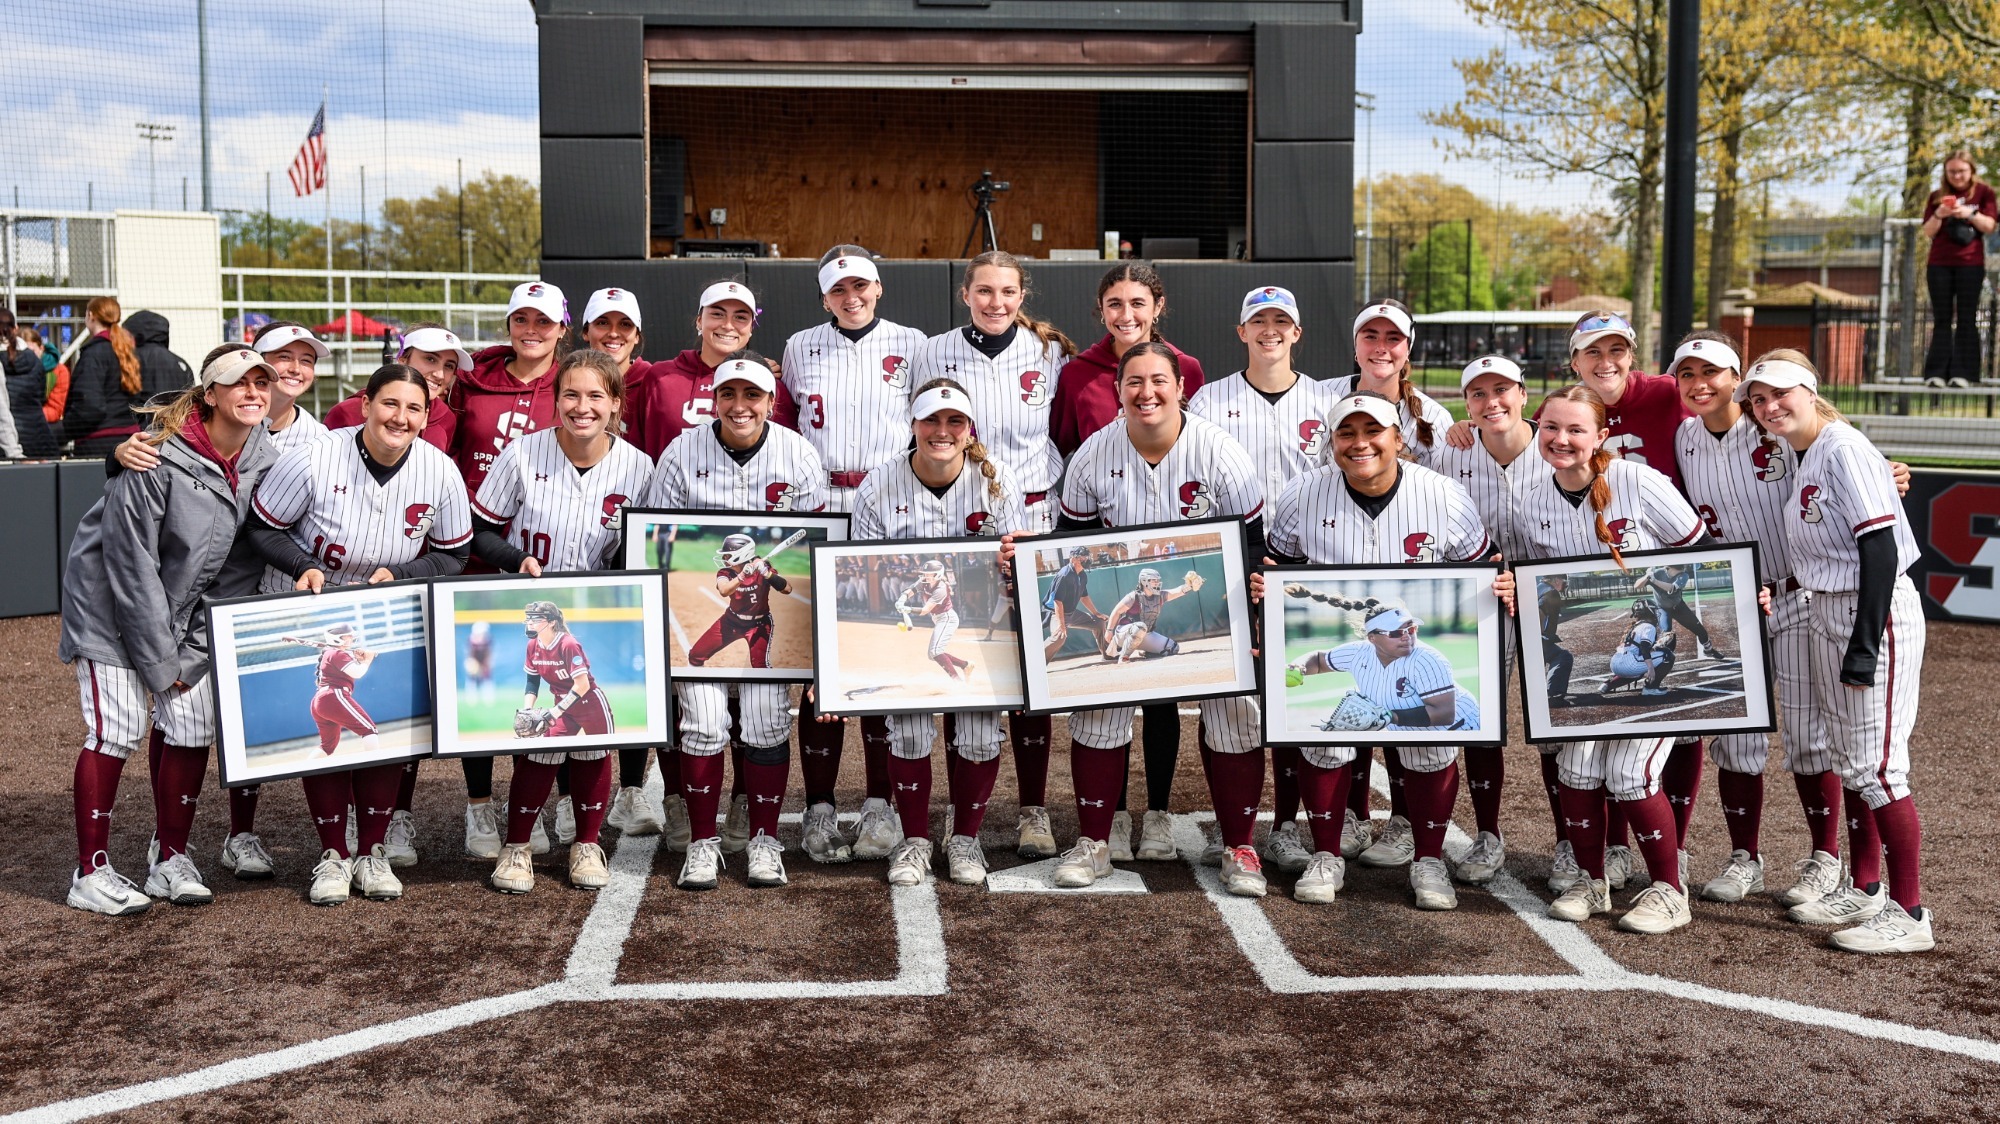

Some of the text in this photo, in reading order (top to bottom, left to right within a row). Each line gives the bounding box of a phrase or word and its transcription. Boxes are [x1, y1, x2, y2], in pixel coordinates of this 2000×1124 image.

[838, 259, 848, 269] S
[527, 284, 545, 298] S
[607, 289, 623, 301] S
[882, 355, 909, 389] S
[1020, 370, 1047, 406] S
[808, 394, 825, 429] 3
[1299, 419, 1327, 456] S
[1751, 444, 1787, 483] S
[600, 493, 632, 530] S
[766, 482, 796, 512] S
[1179, 480, 1212, 519] S
[1800, 484, 1823, 524] S
[404, 503, 436, 540] S
[313, 534, 347, 571] 16
[521, 528, 552, 567] 10
[1403, 532, 1435, 563] S
[1926, 481, 2000, 621] S
[749, 593, 758, 604] 2
[555, 668, 570, 680] 10
